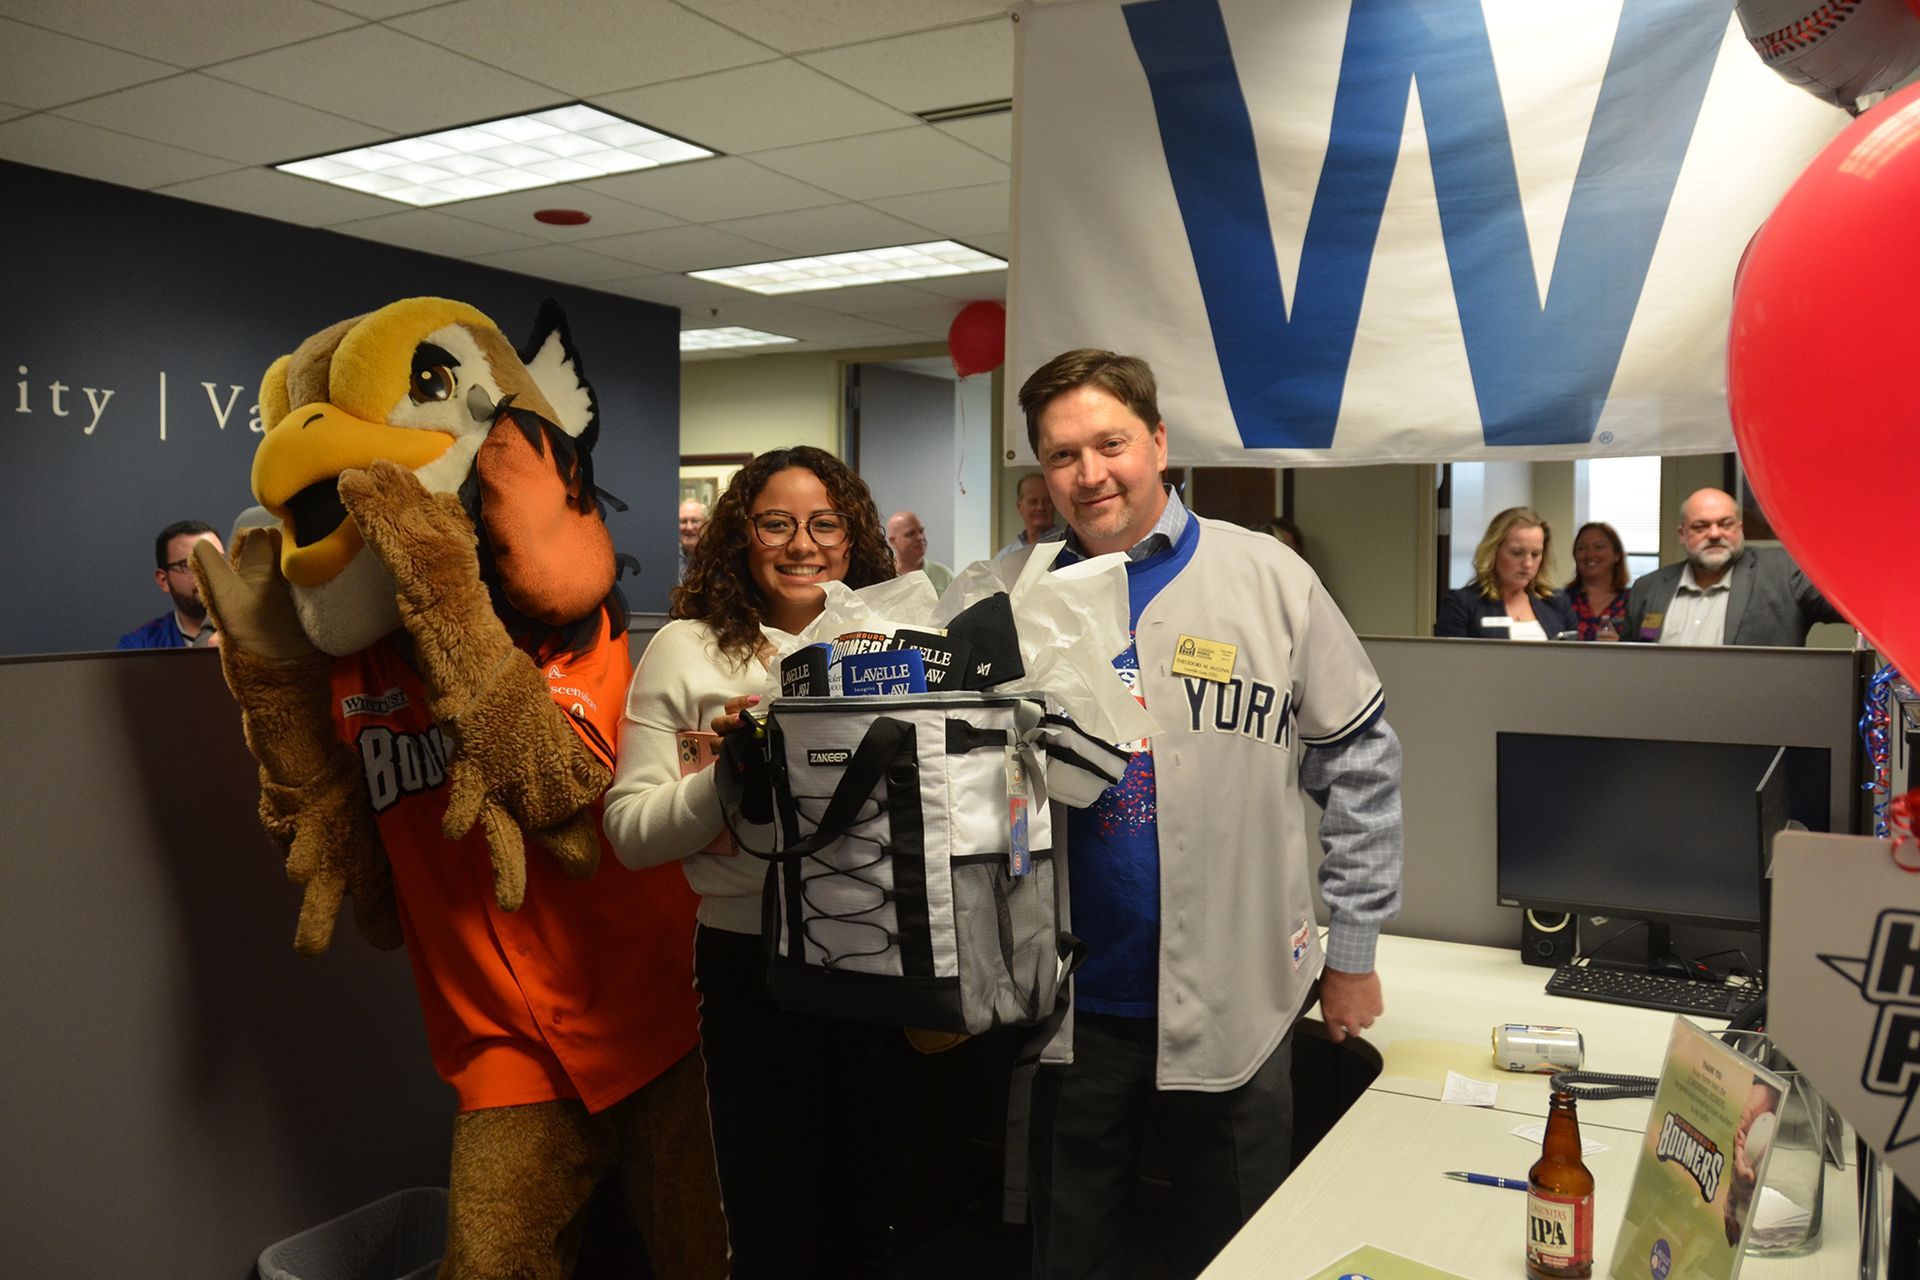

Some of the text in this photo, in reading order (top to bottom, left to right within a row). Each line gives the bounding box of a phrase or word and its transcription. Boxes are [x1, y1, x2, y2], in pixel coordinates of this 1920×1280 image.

[1122, 0, 1735, 449] W
[850, 663, 910, 683] LAVELLE
[876, 682, 910, 697] LAW
[1182, 675, 1293, 751] YORK
[810, 752, 849, 763] ZAKEEP
[1657, 1113, 1723, 1201] BOOMERS
[1531, 1215, 1568, 1246] IPA
